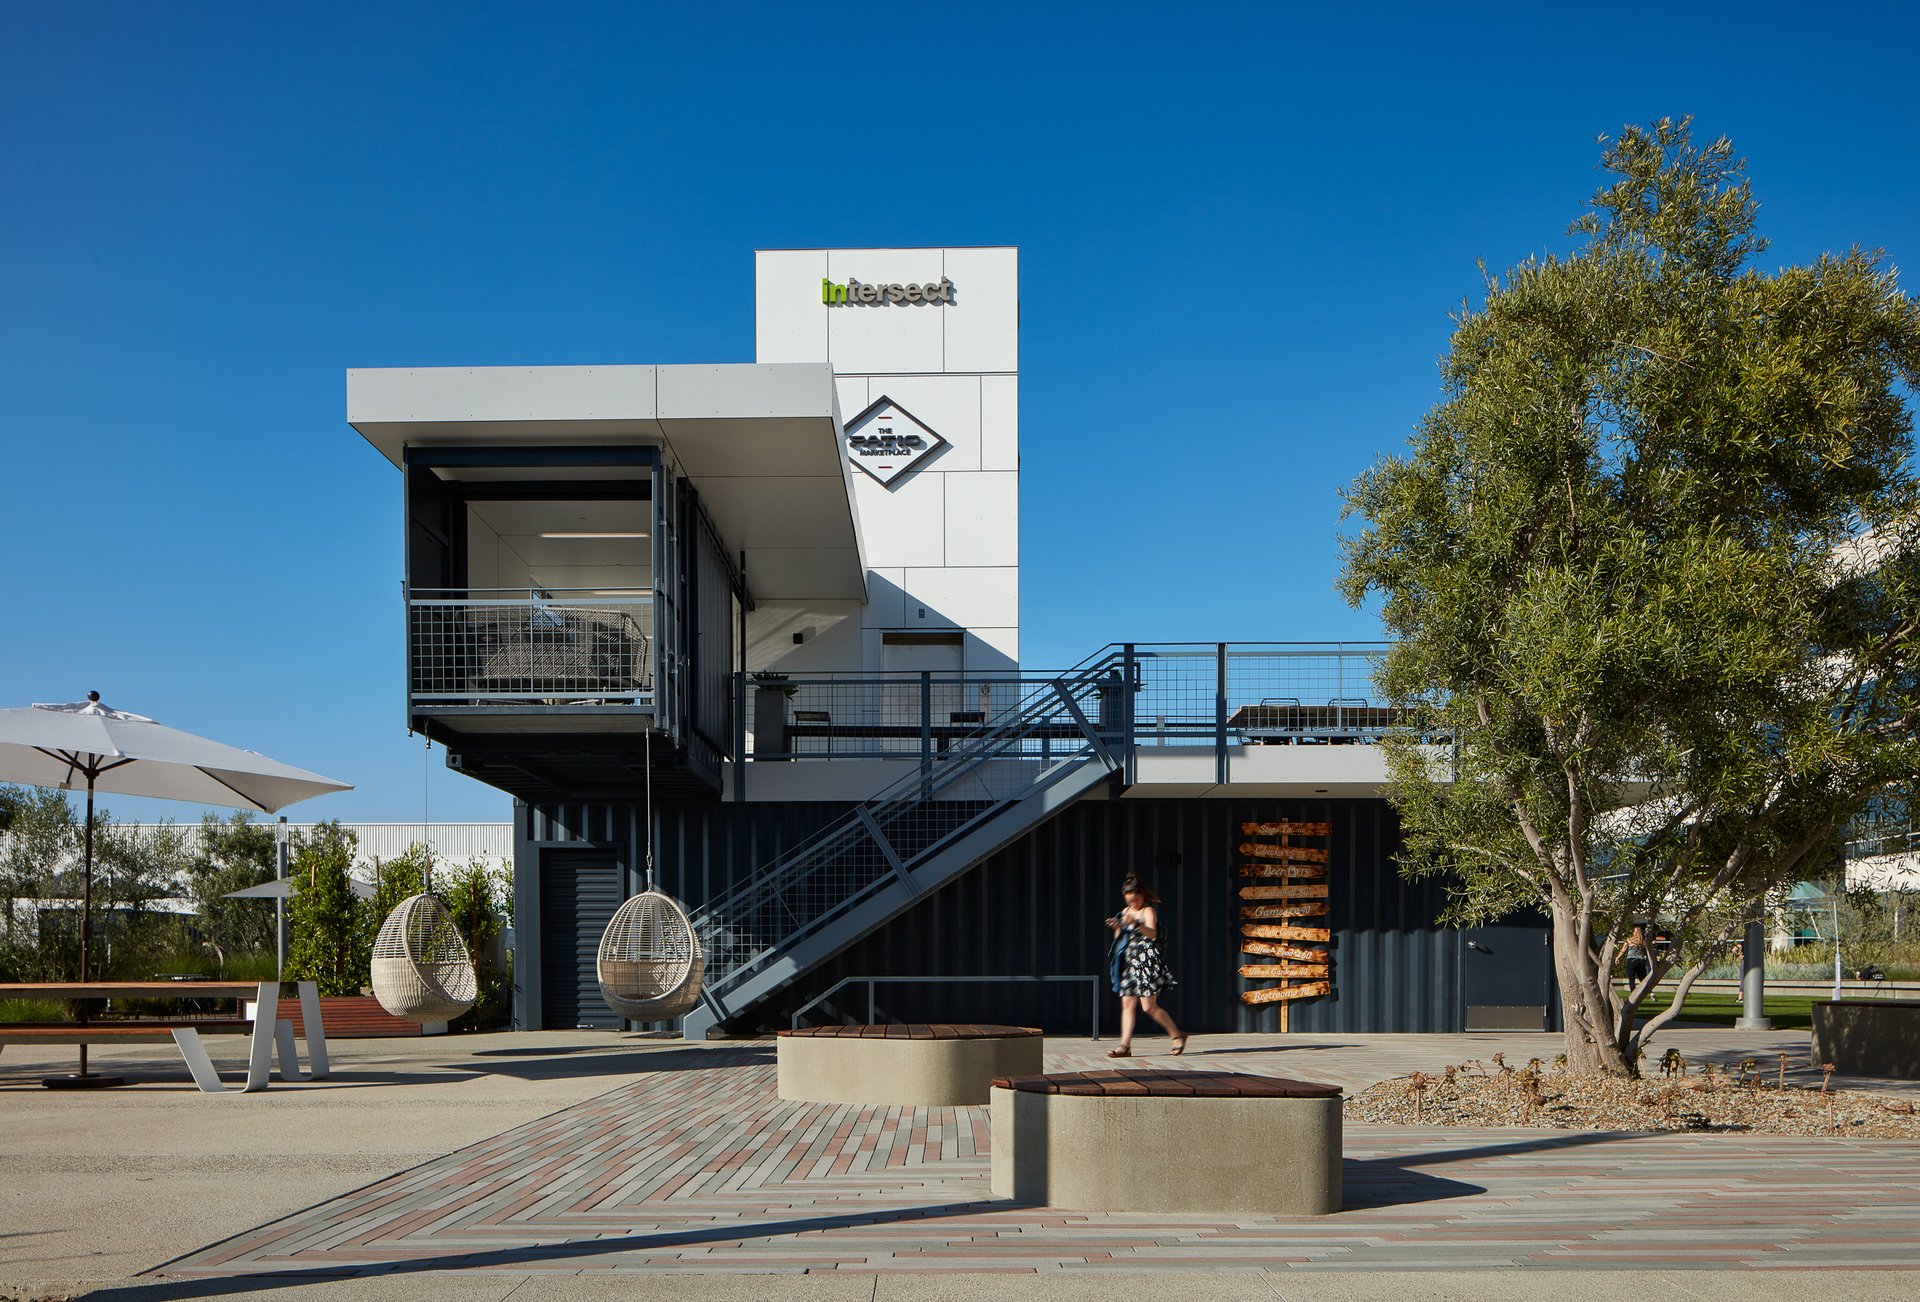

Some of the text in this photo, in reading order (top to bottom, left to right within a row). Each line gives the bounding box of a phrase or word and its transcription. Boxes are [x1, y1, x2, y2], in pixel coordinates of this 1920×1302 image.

[822, 276, 950, 304] intersect
[849, 435, 921, 447] PATIO
[1264, 864, 1285, 875] Beer
[1255, 906, 1288, 917] Games
[1248, 944, 1270, 954] Coffee
[1276, 947, 1294, 957] Food
[1301, 950, 1312, 959] 60
[1247, 967, 1269, 975] Urban
[1271, 967, 1298, 975] Gardens
[1254, 987, 1310, 1001] Restrooms 70
